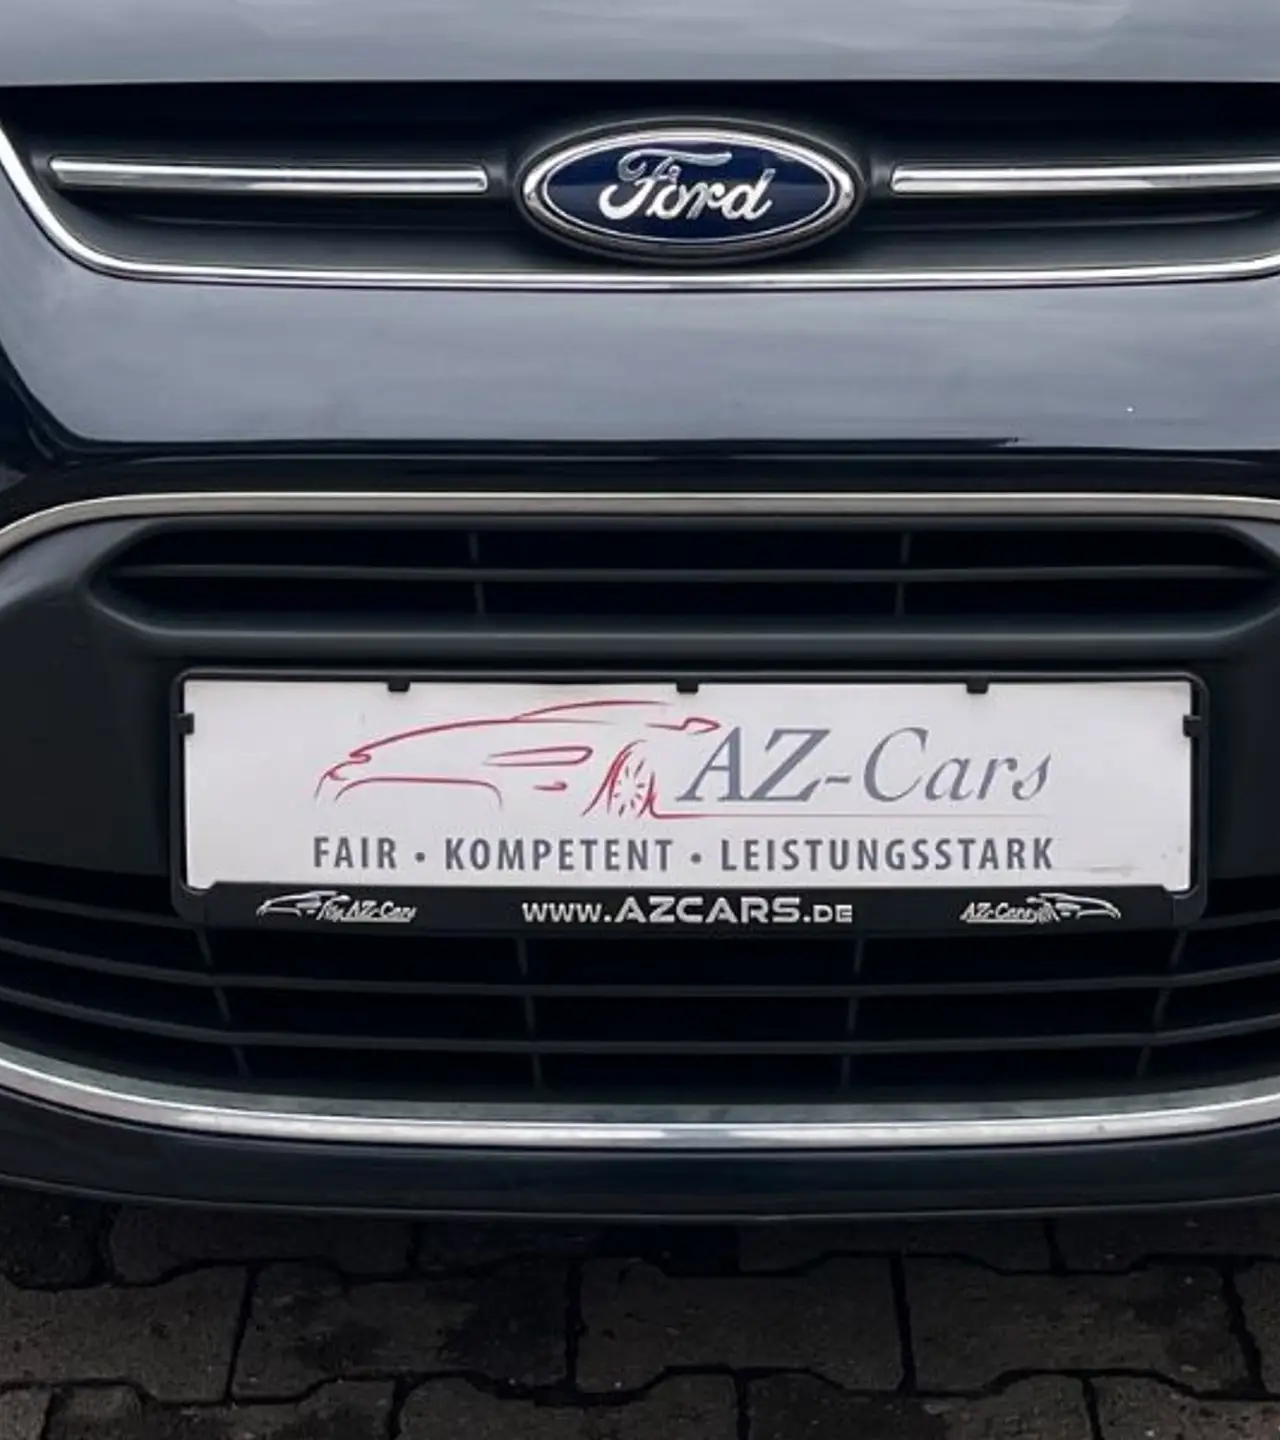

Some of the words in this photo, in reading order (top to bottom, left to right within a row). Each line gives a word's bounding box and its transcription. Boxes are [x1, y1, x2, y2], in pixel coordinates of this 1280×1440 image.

[599, 148, 777, 221] Ford
[675, 726, 1052, 803] AZ-Cars
[314, 836, 397, 869] FAIR
[445, 837, 673, 871] KOMPETENT
[721, 837, 1054, 871] LEISTUNGSSTARK
